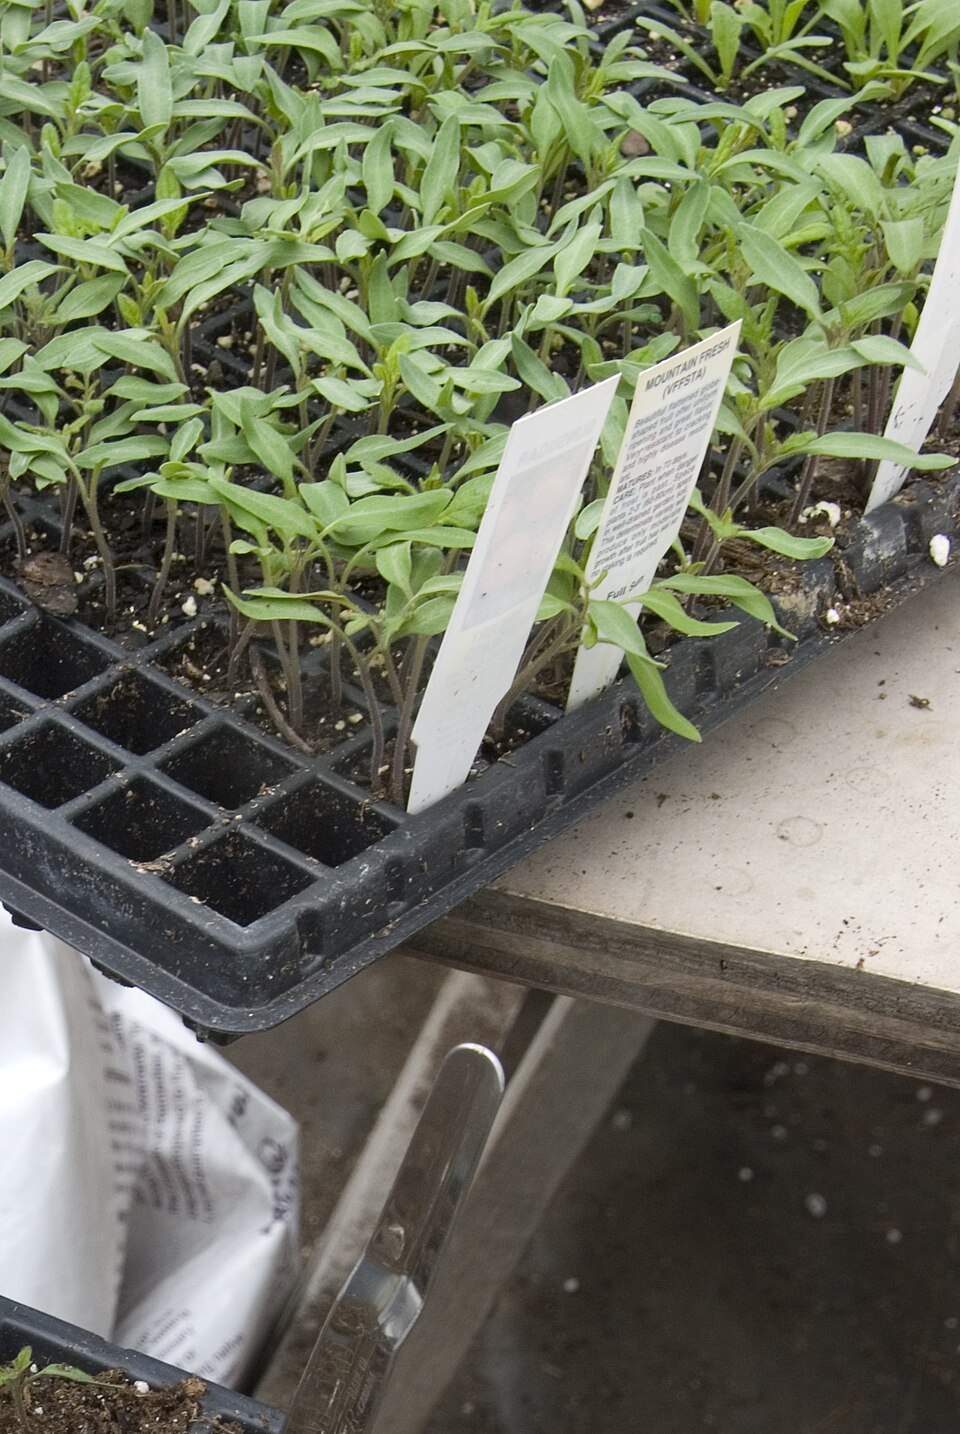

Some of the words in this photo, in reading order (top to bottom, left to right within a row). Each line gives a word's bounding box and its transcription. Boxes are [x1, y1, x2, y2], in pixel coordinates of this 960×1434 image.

[644, 356, 698, 391] MOUNTAIN
[698, 338, 731, 363] FRESH
[661, 366, 707, 399] (VFFSTA)
[636, 449, 658, 465] highly
[659, 434, 686, 452] disease
[612, 486, 637, 504] CARE:
[637, 476, 656, 491] Plant
[657, 466, 675, 480] when
[675, 454, 698, 472] danger
[615, 468, 654, 494] MATURES:
[672, 464, 696, 481] Space
[651, 494, 674, 512] garden
[596, 536, 628, 558] produce
[630, 527, 646, 541] only
[600, 533, 615, 545] This
[607, 586, 627, 601] Full
